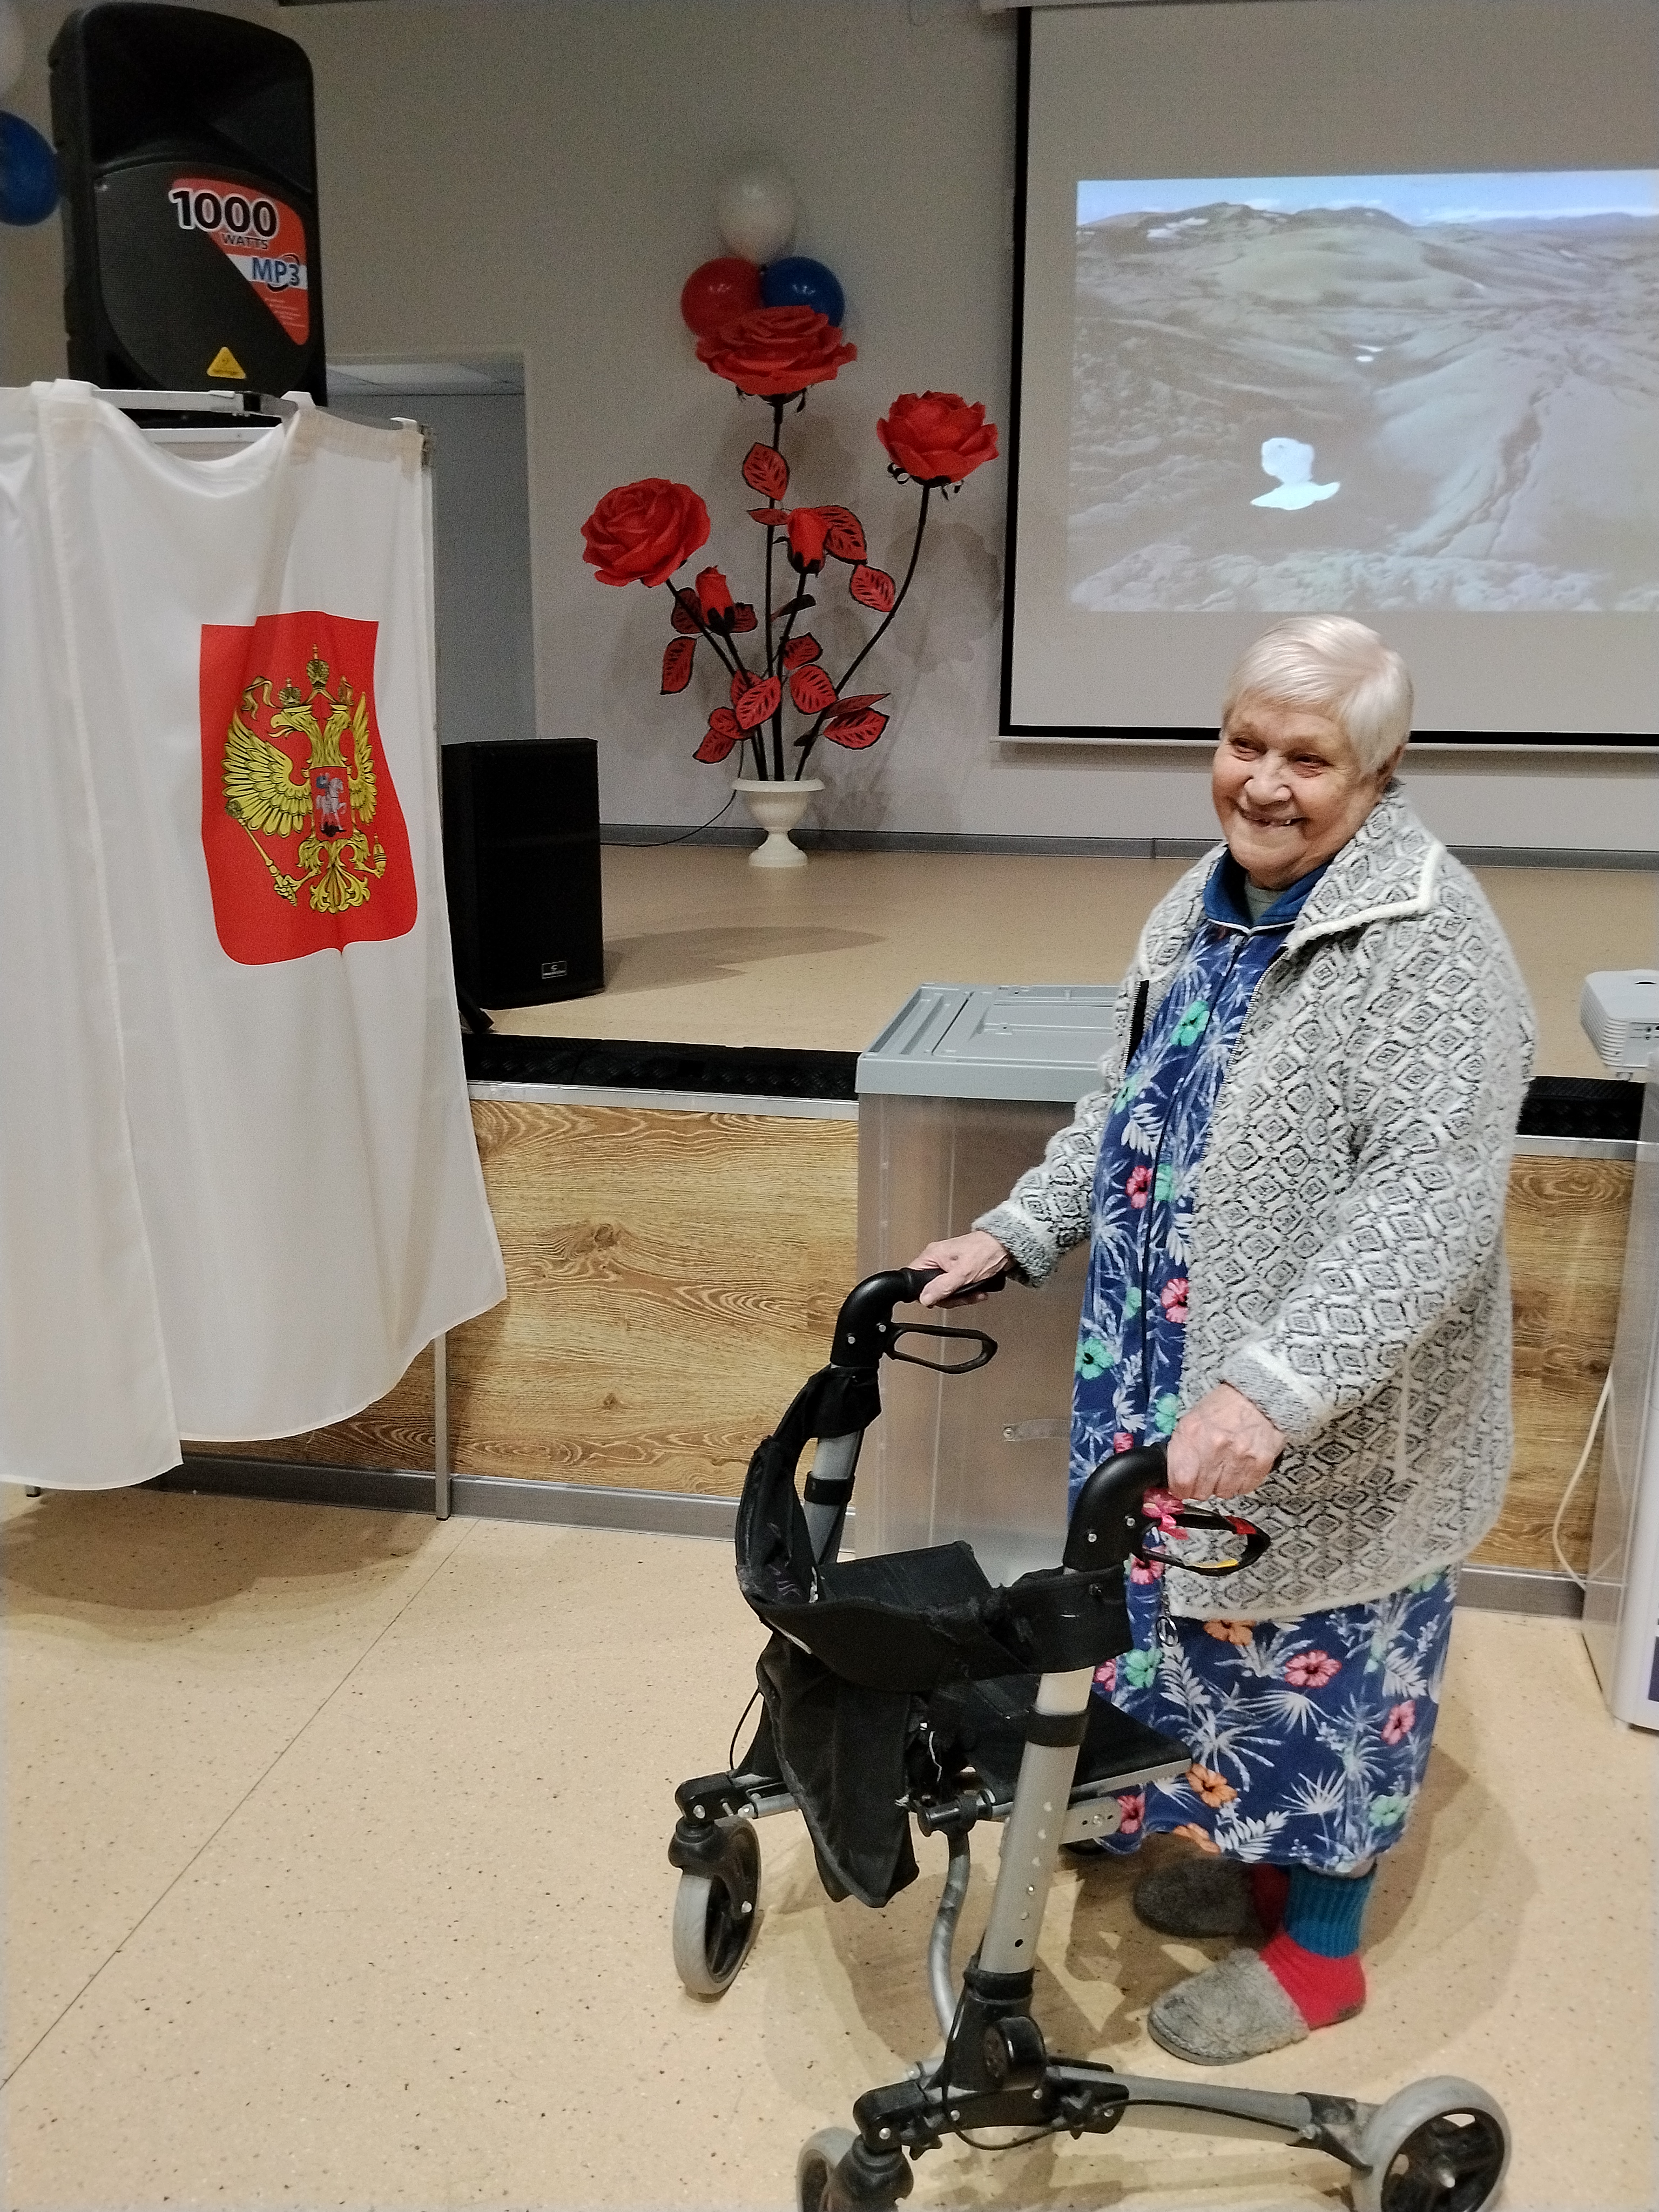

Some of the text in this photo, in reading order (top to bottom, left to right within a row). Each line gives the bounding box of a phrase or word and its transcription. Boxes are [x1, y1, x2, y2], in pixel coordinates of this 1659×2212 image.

[171, 189, 278, 238] 1000
[220, 233, 268, 249] WATTS
[252, 257, 300, 286] MP3
